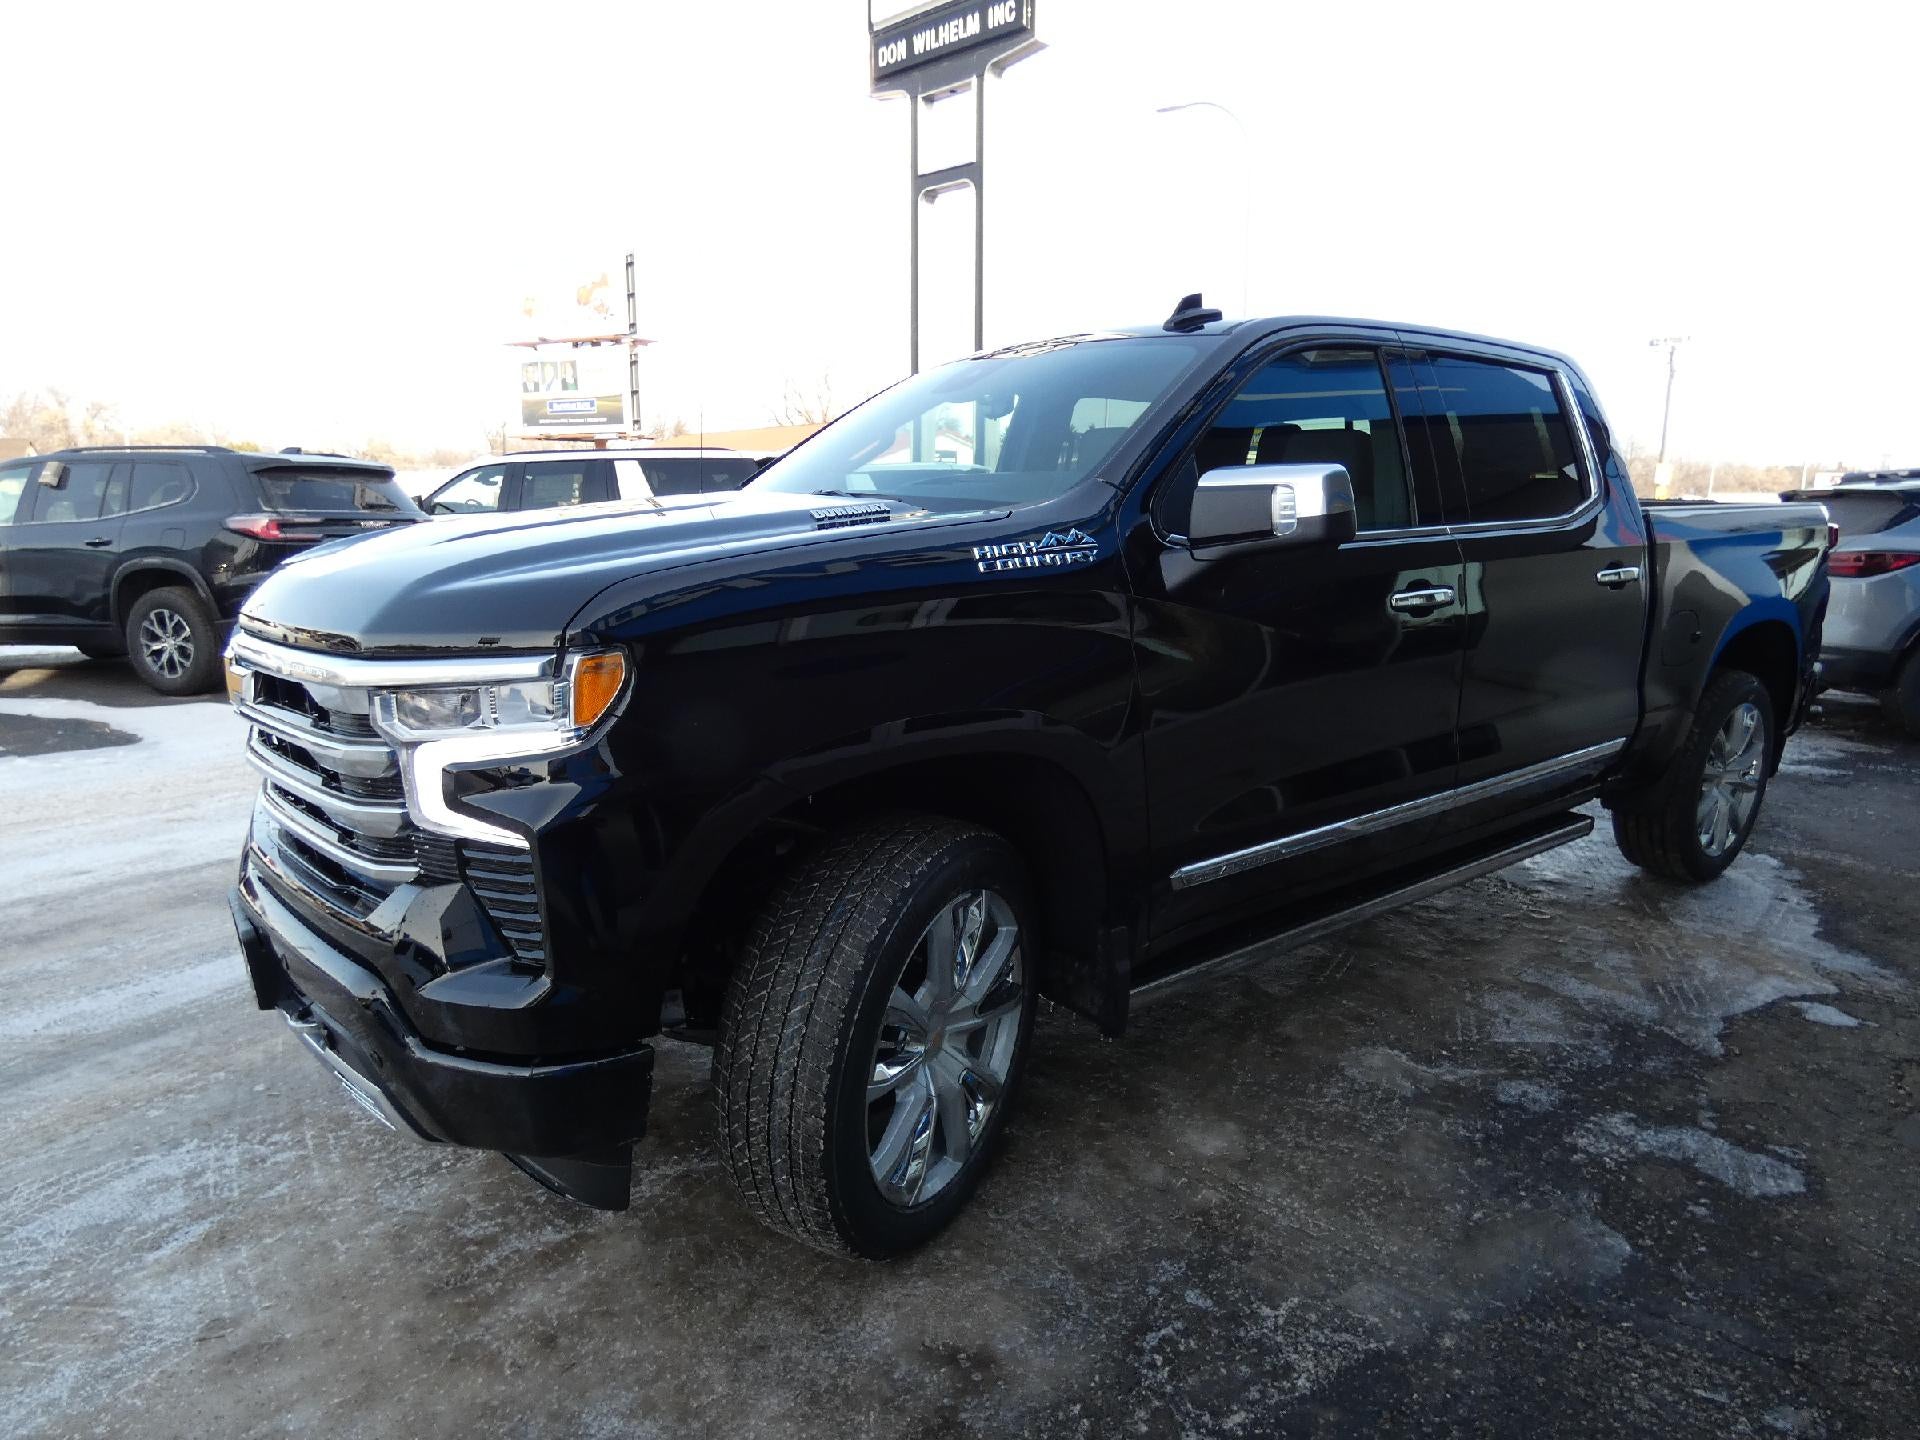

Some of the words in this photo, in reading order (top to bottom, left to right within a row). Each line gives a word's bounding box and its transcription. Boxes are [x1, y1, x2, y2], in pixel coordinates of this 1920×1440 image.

[878, 38, 907, 67] DON
[912, 11, 980, 55] WILHELM
[988, 0, 1016, 29] INC
[972, 541, 1037, 560] HIGH
[978, 550, 1098, 573] COUNTRY
